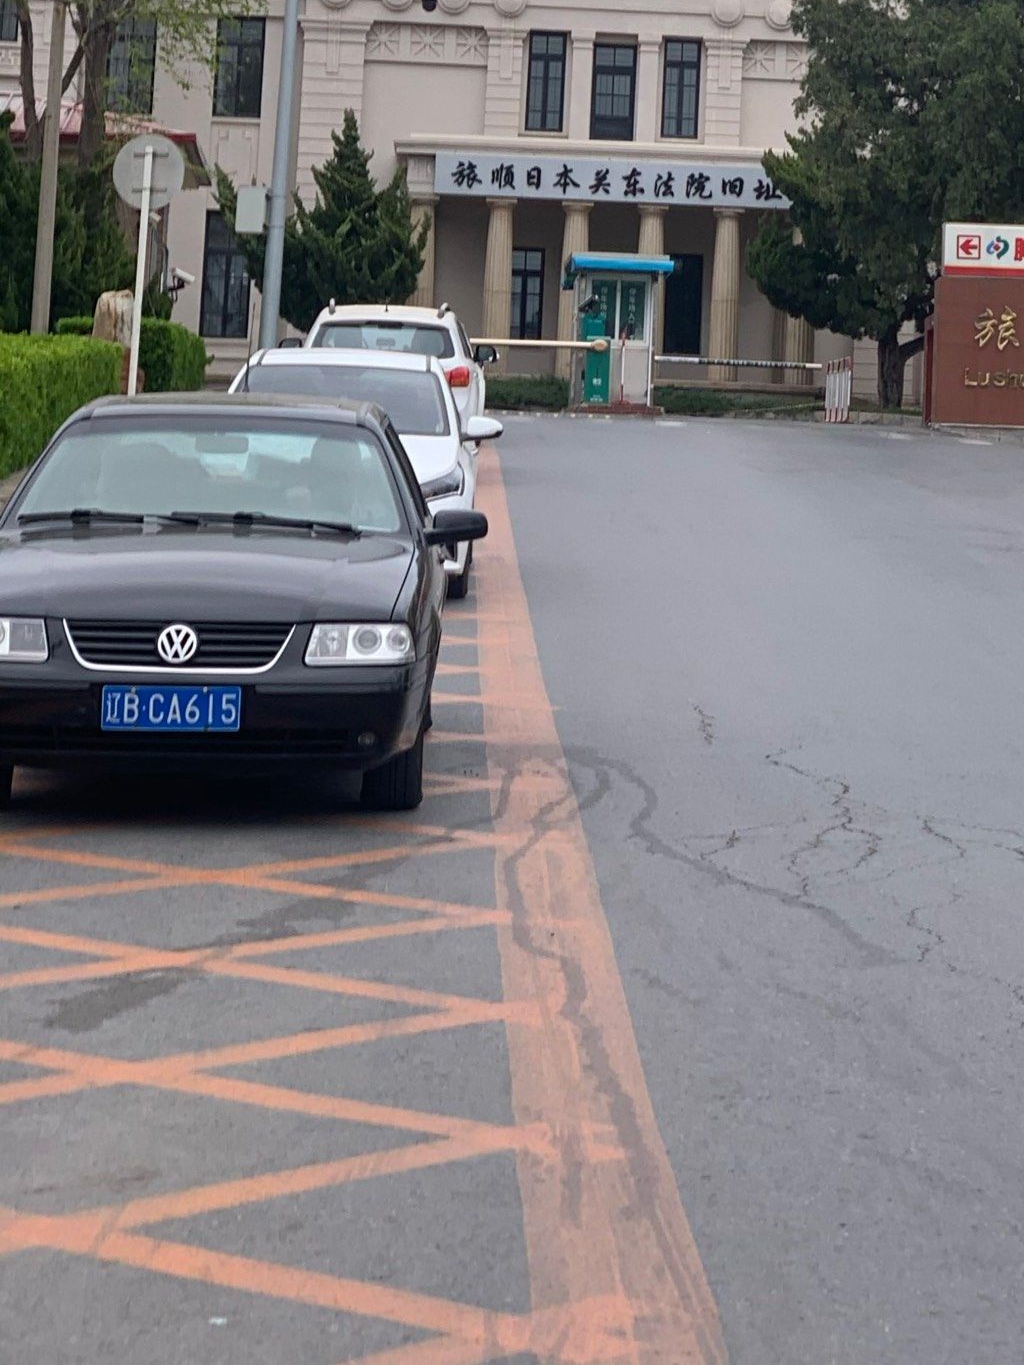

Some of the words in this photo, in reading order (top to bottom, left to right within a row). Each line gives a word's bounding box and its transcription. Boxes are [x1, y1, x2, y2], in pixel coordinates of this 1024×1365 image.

[451, 160, 785, 201] 旅顺日本关东法院旧址
